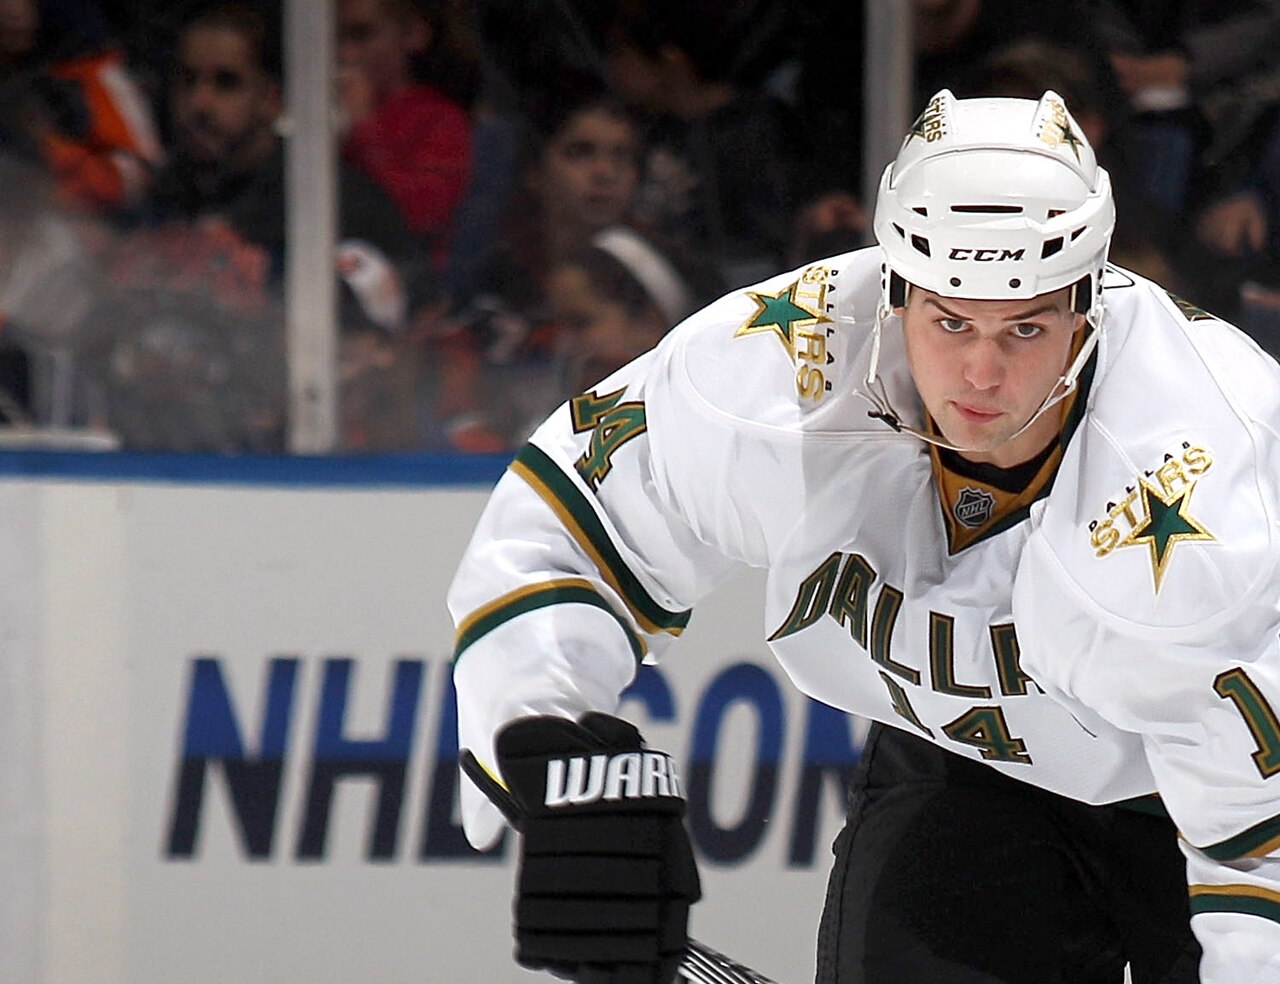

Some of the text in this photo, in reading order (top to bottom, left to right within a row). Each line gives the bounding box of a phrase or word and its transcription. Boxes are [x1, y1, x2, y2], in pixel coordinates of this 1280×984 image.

[948, 248, 1026, 262] CCM
[796, 265, 830, 401] STARS
[569, 384, 648, 495] 14
[1088, 441, 1191, 532] DALLAS
[961, 501, 988, 517] NHL
[1090, 446, 1213, 557] STARS
